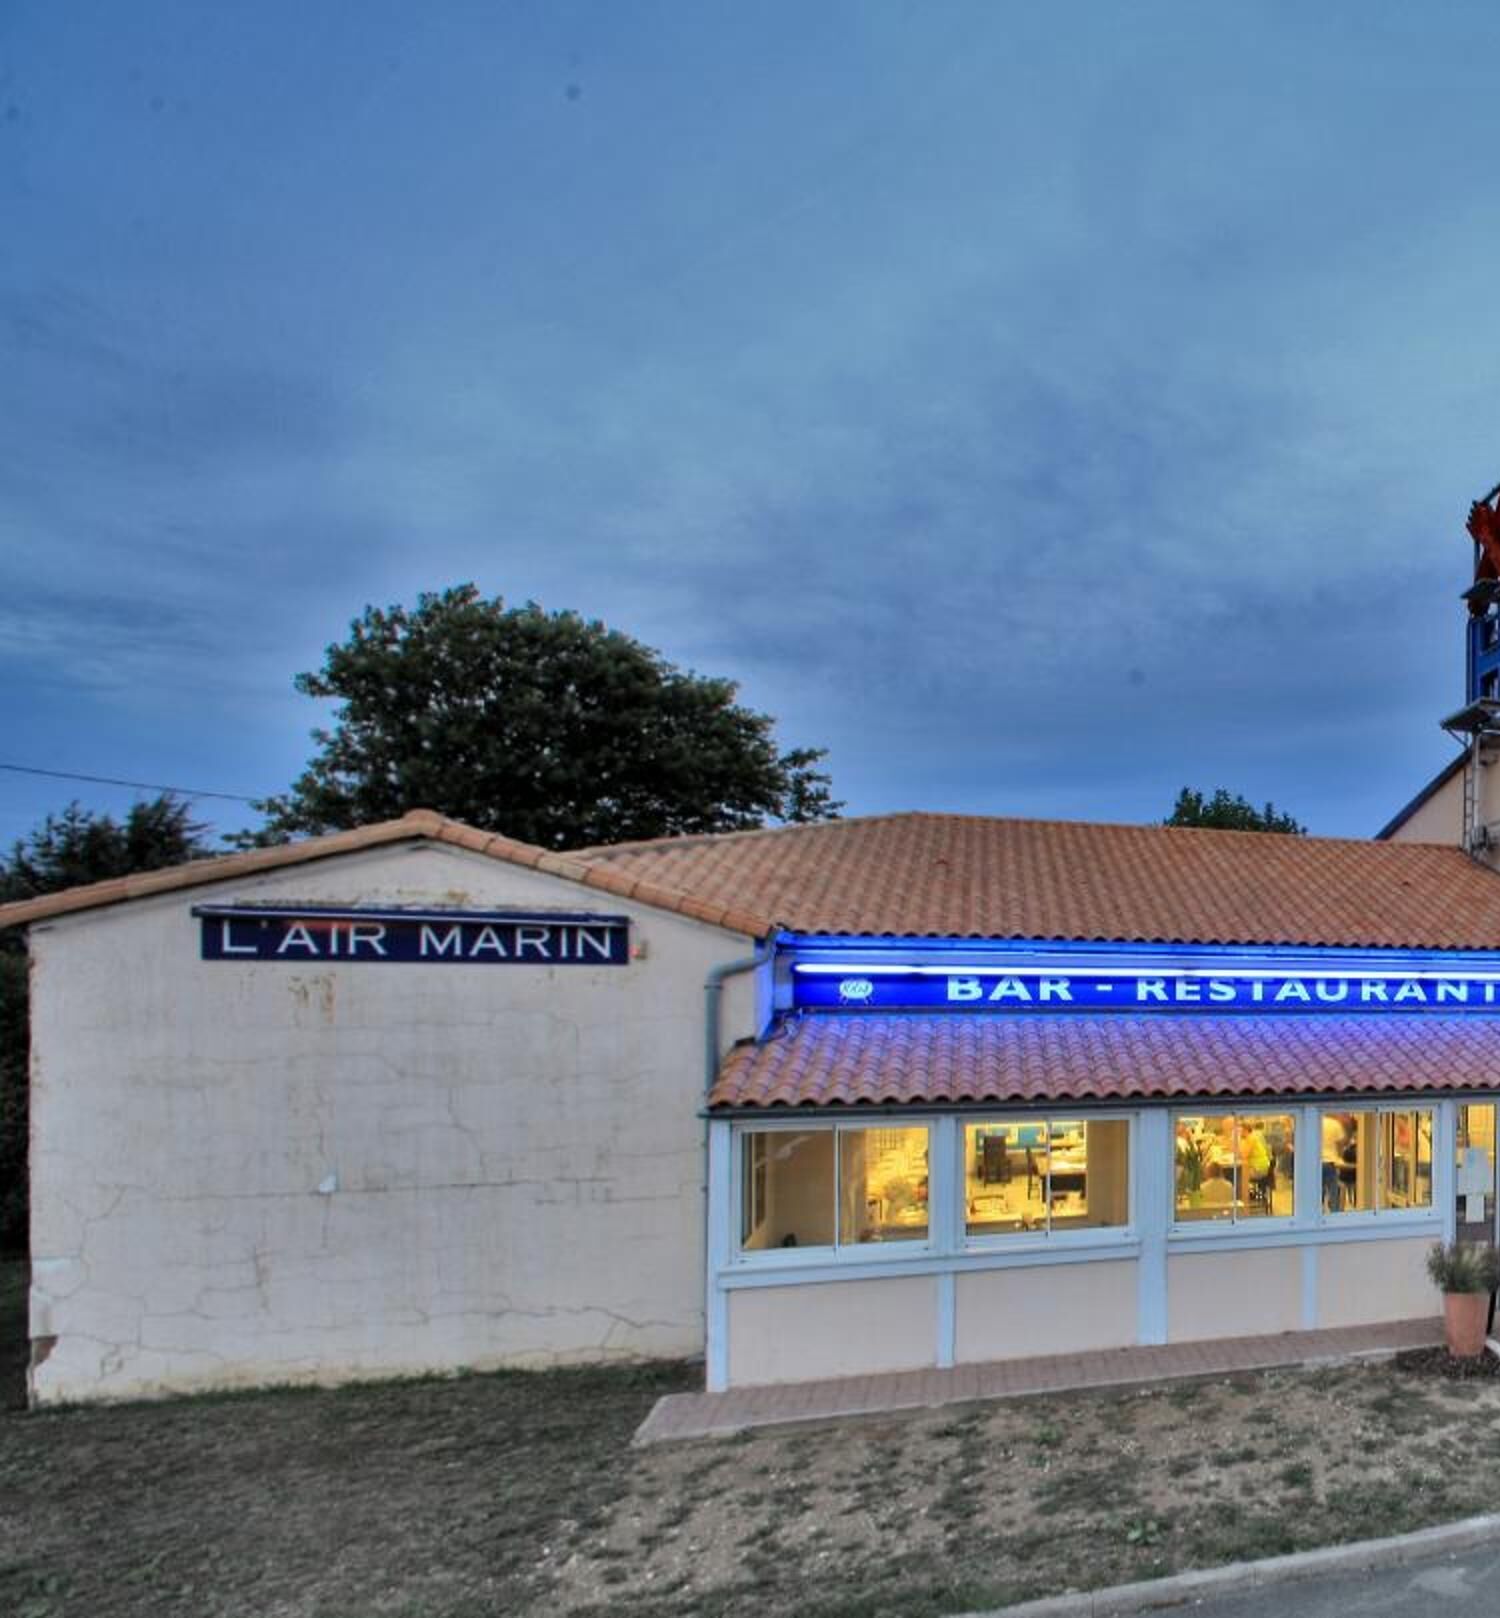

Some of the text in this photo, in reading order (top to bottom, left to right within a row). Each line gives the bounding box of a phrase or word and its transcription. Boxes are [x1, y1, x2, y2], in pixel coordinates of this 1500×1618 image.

[222, 920, 612, 958] L'AIR MARIN
[947, 975, 1073, 1001] BAR
